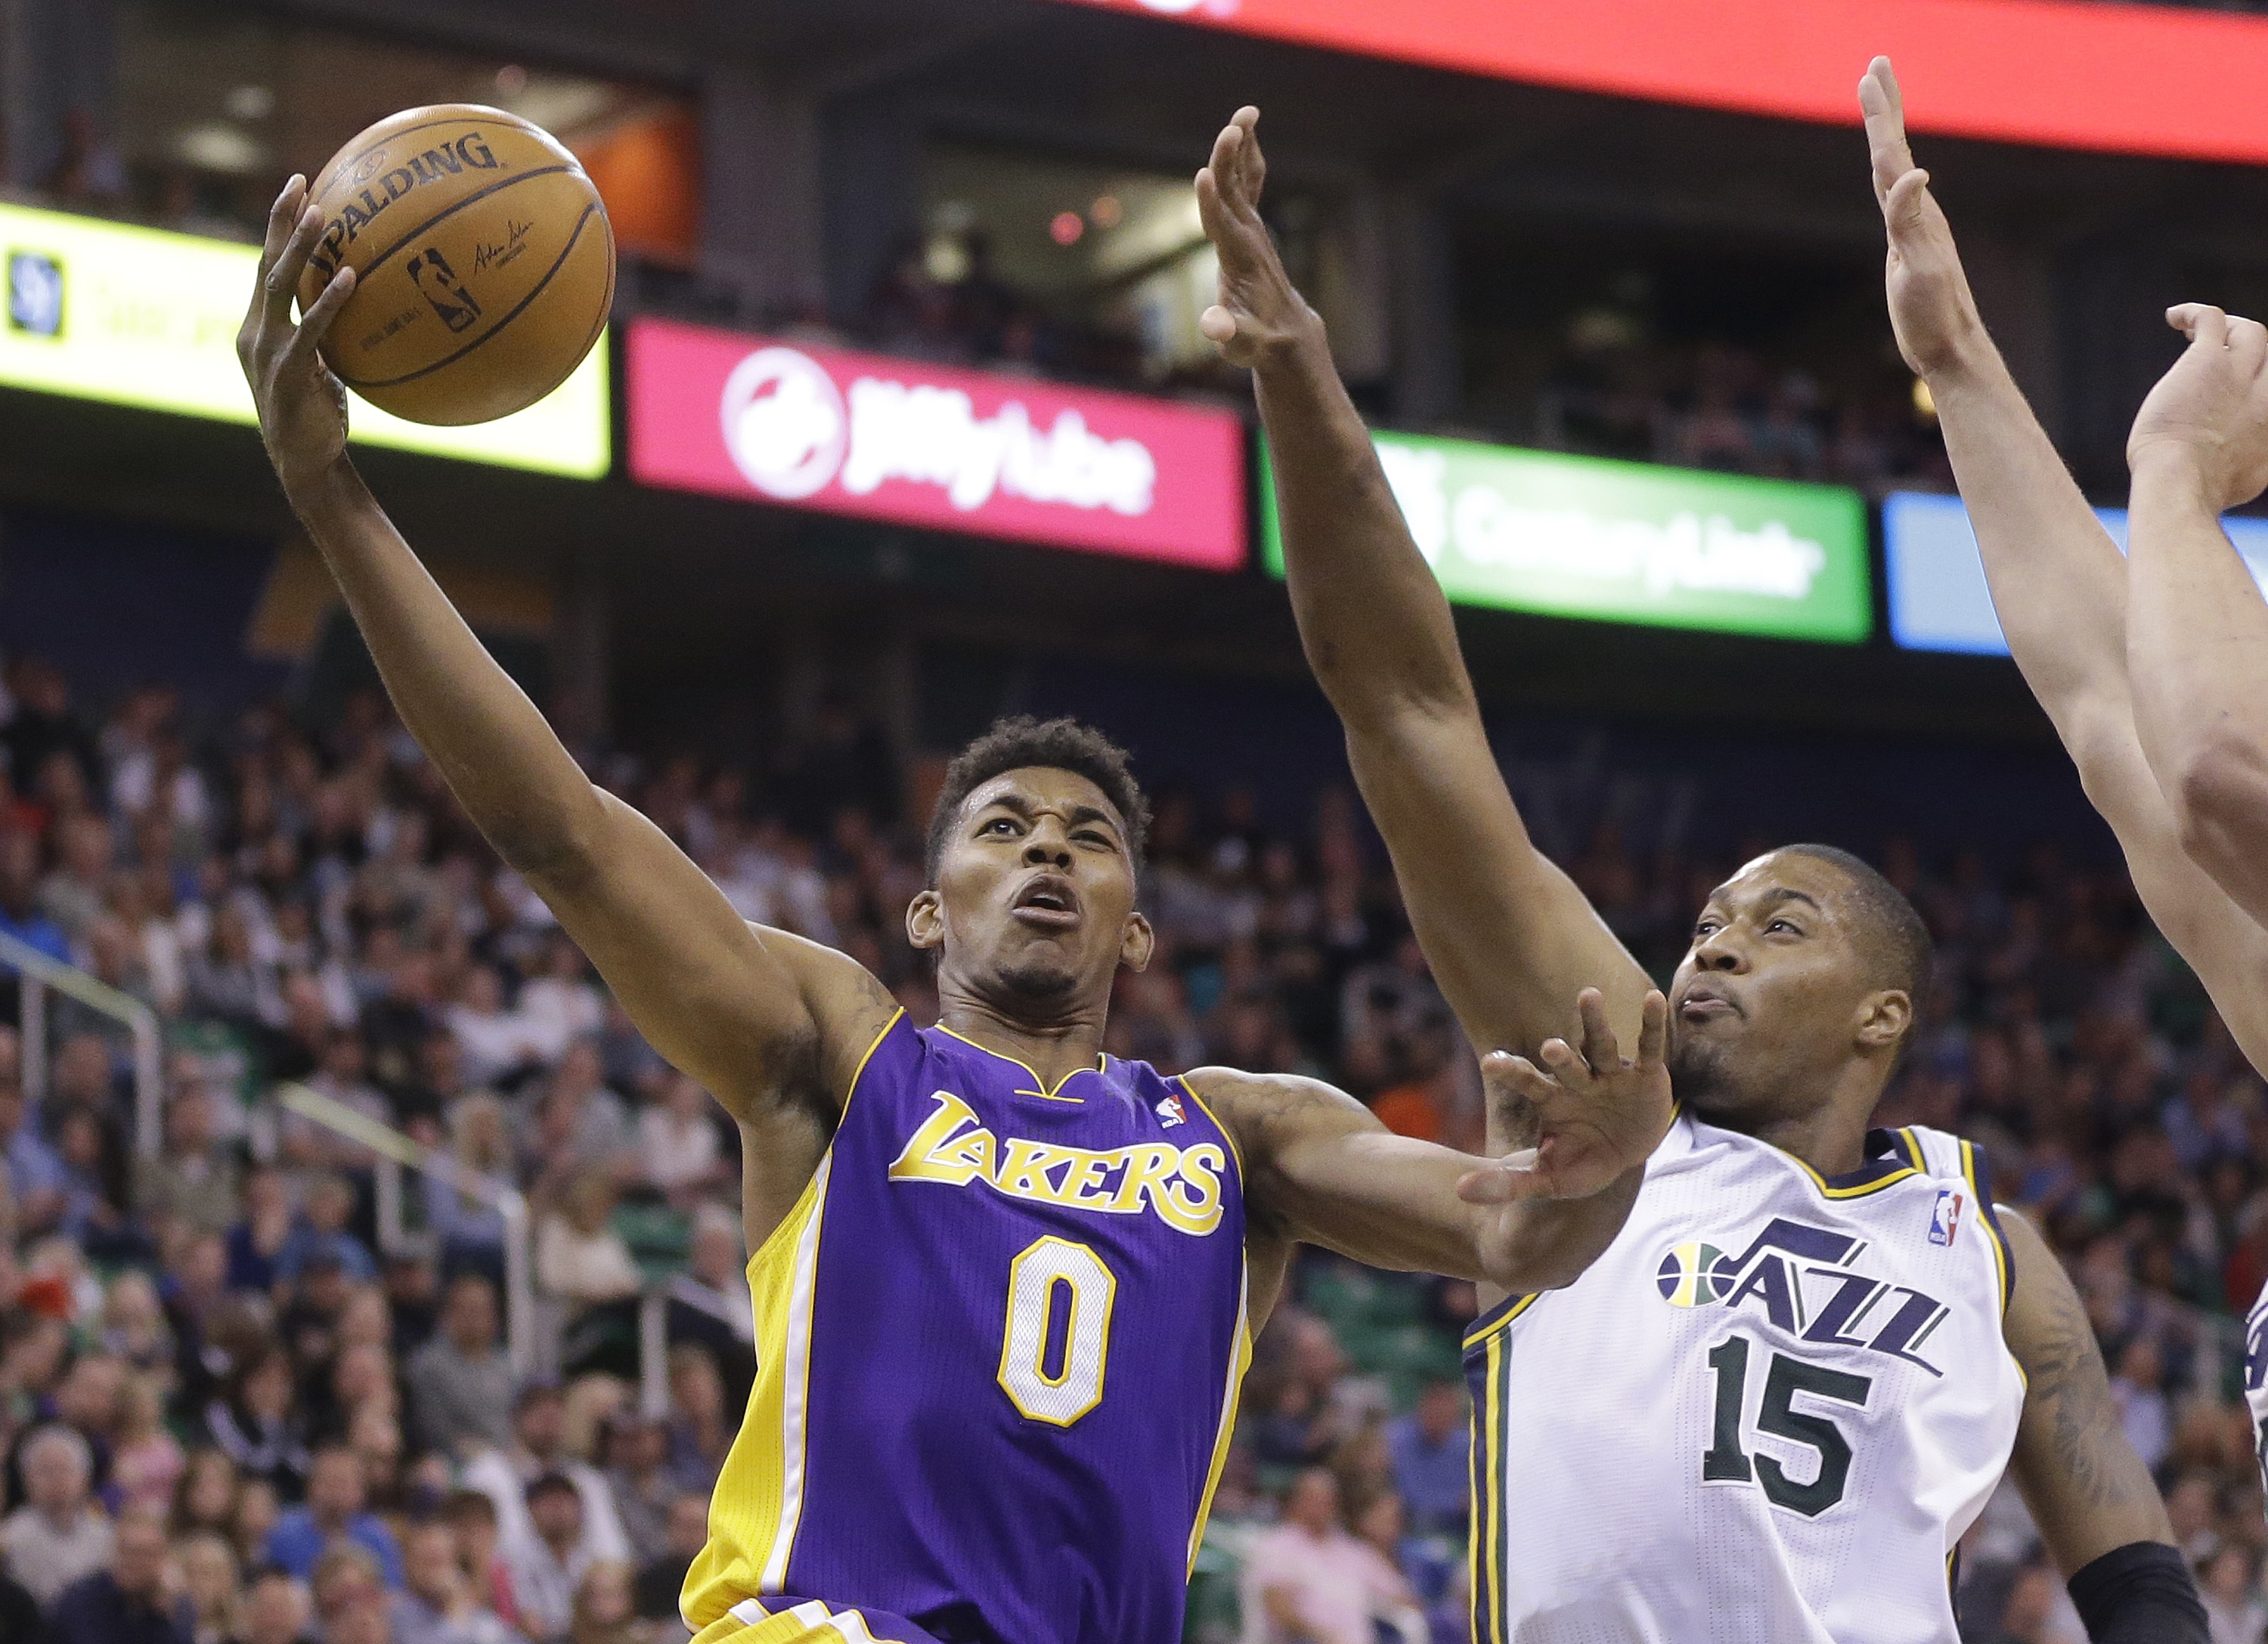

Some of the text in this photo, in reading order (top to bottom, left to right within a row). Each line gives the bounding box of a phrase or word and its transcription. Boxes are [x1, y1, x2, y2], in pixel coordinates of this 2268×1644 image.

[888, 1089, 1226, 1237] LAKERS
[996, 1234, 1117, 1429] 0
[1656, 1217, 1951, 1378] JAZZ
[1703, 1334, 1873, 1519] 15
